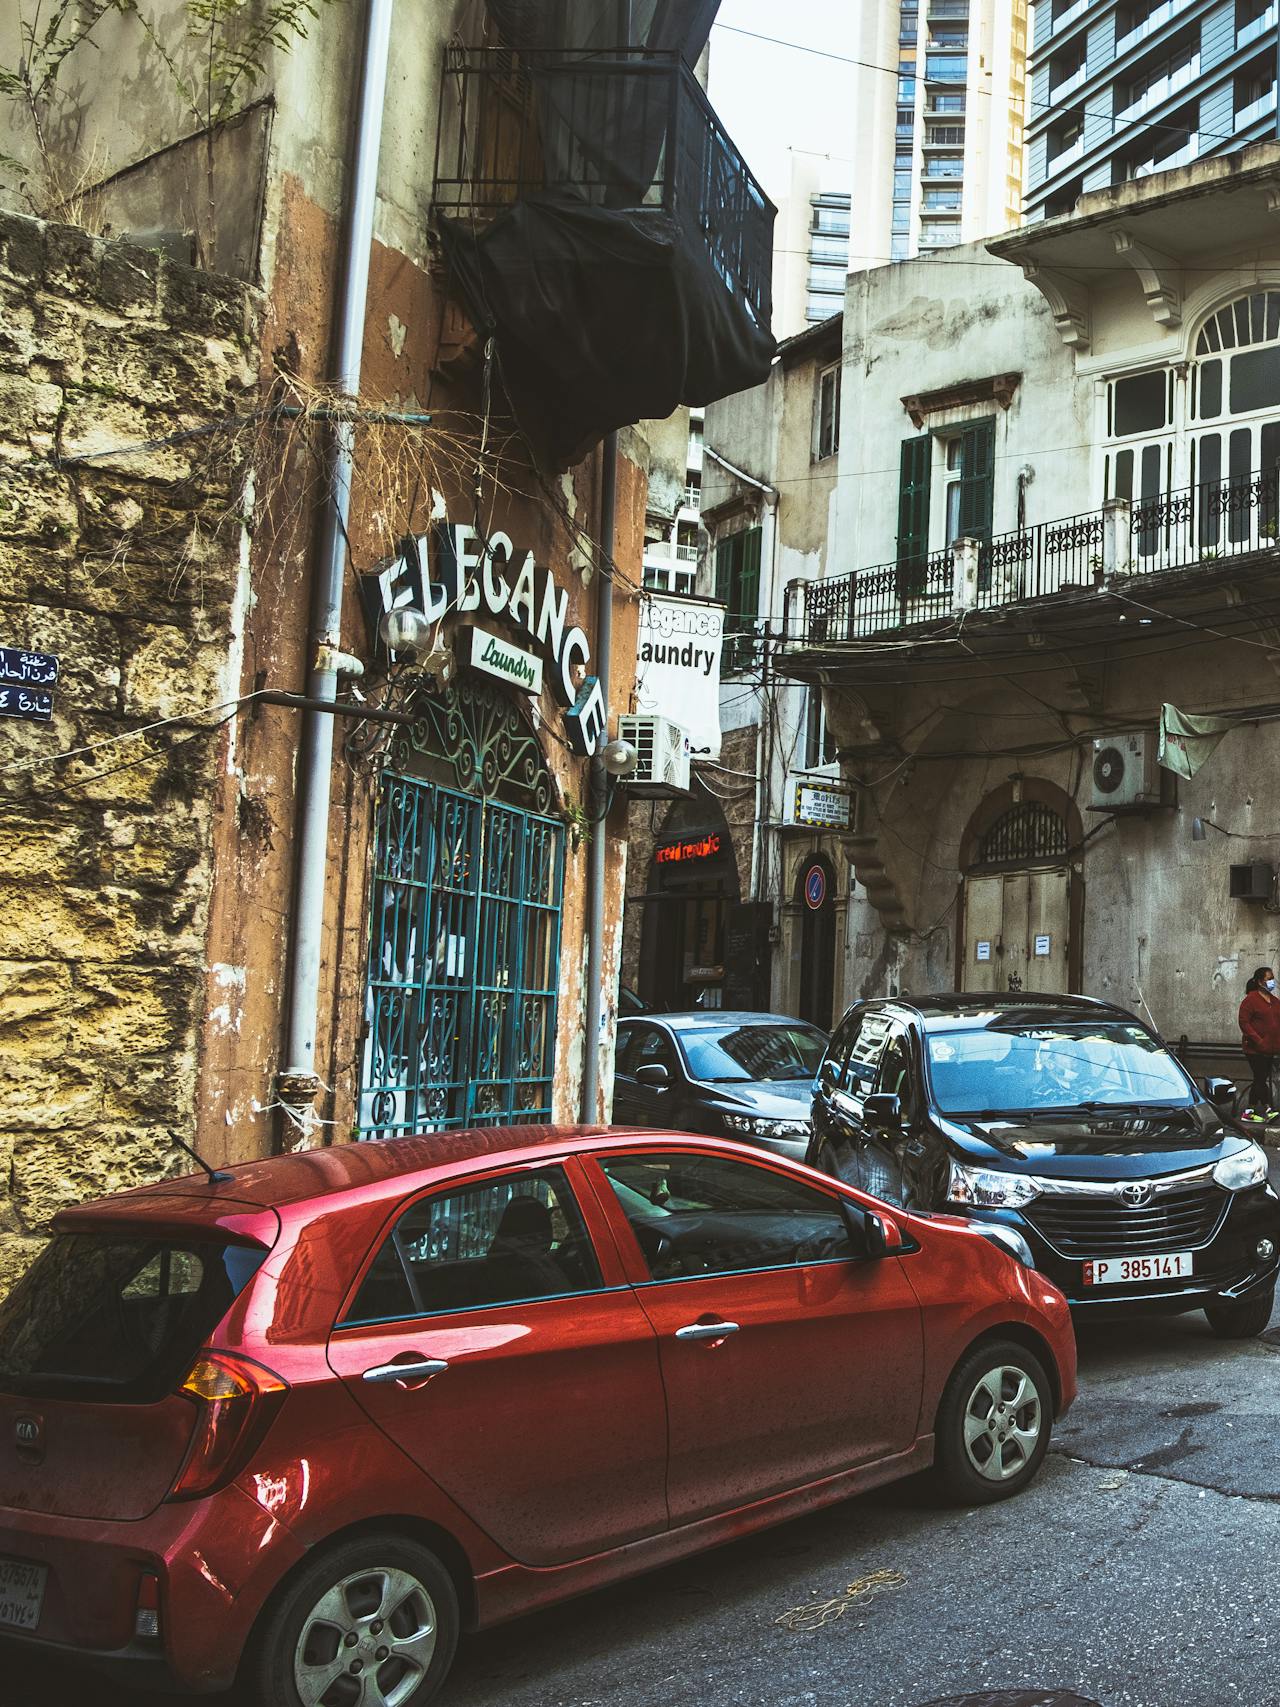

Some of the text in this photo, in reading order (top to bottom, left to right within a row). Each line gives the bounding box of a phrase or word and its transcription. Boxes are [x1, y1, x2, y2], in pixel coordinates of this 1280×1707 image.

[481, 638, 536, 687] Laundry
[637, 642, 715, 676] aundry
[0, 663, 31, 680] الحاي
[19, 692, 51, 713] شارع
[1098, 1263, 1109, 1280] P
[1120, 1256, 1182, 1280] 385141
[16, 1423, 33, 1439] KIA
